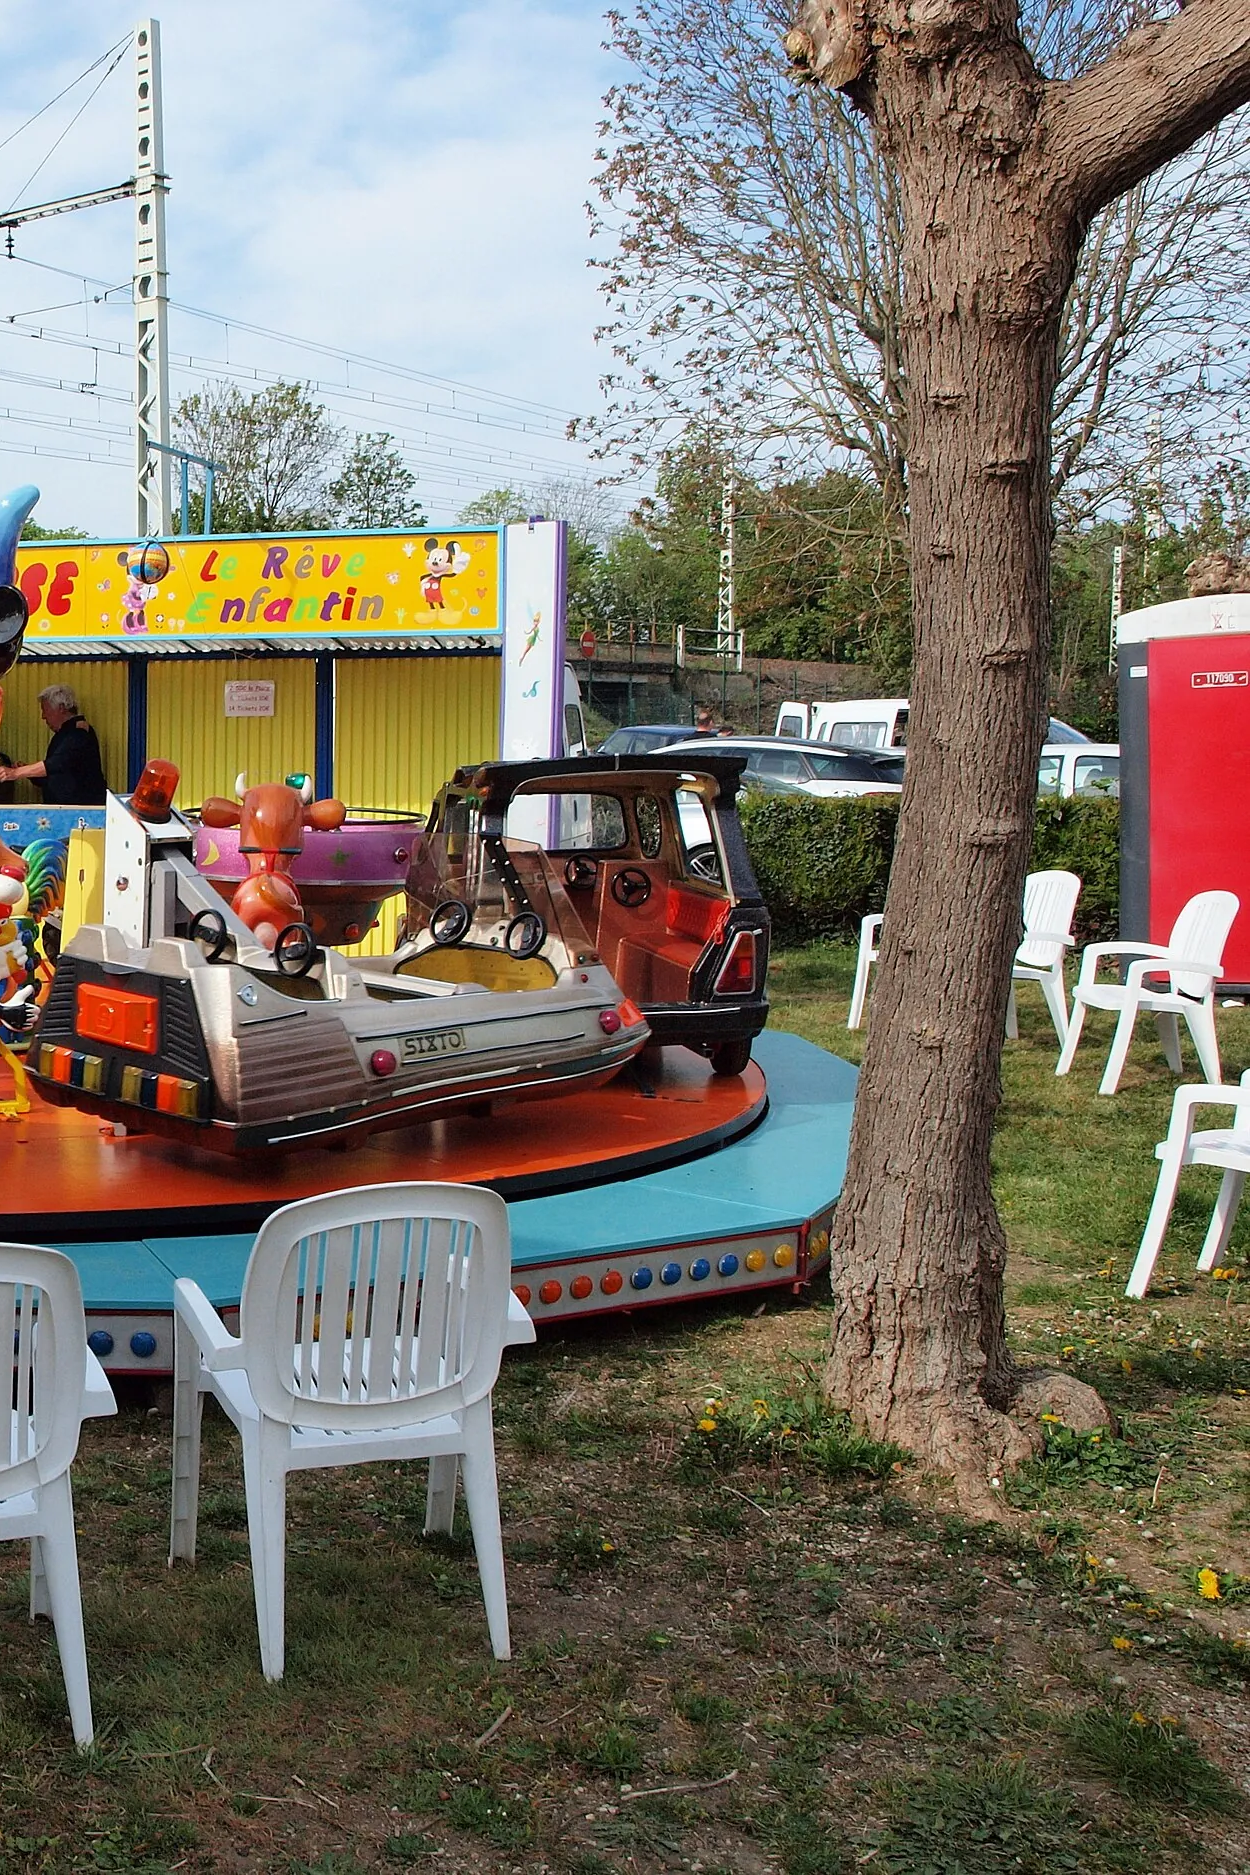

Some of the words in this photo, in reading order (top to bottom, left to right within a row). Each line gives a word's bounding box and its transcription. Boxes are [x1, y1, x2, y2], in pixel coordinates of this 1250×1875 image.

[200, 549, 238, 582] Le
[261, 545, 366, 580] Rêve
[185, 586, 384, 623] Enfantin
[404, 1031, 462, 1057] SIXTO
